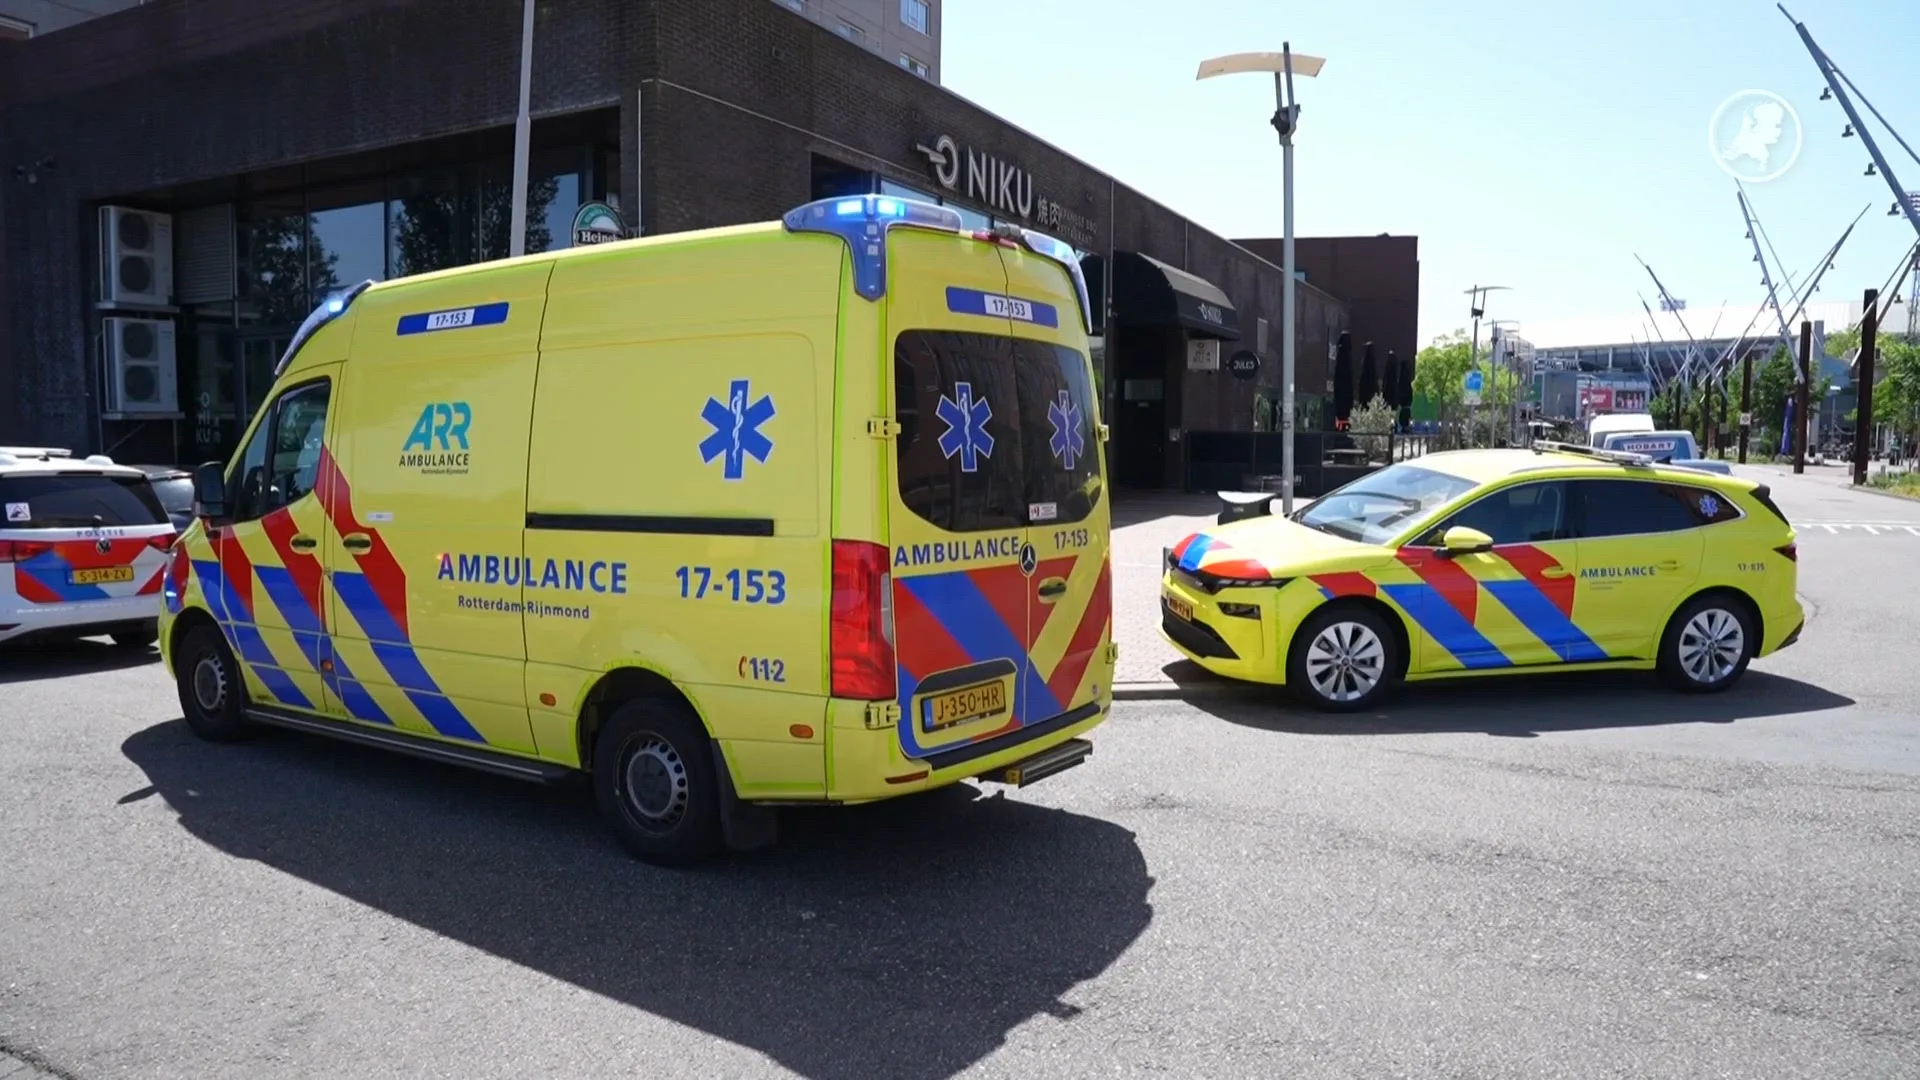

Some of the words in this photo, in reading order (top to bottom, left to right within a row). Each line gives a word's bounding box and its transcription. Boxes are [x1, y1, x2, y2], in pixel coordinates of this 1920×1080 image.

[968, 145, 1032, 217] NIKU
[993, 299, 1025, 316] 17-153
[435, 312, 466, 326] 17-153
[402, 402, 472, 451] ARR
[1627, 442, 1672, 450] HOBART
[399, 453, 469, 467] AMBULANCE
[76, 529, 125, 537] POLITIE
[894, 536, 1019, 567] AMBULANCE
[1054, 529, 1088, 549] 17-153
[80, 569, 127, 582] S-314-ZV
[438, 552, 627, 594] AMBULANCE
[675, 566, 786, 605] 17-153
[1580, 565, 1656, 578] AMBULANCE
[458, 595, 589, 619] Rotterdam-Rijnmond
[938, 687, 999, 720] J-350-HR
